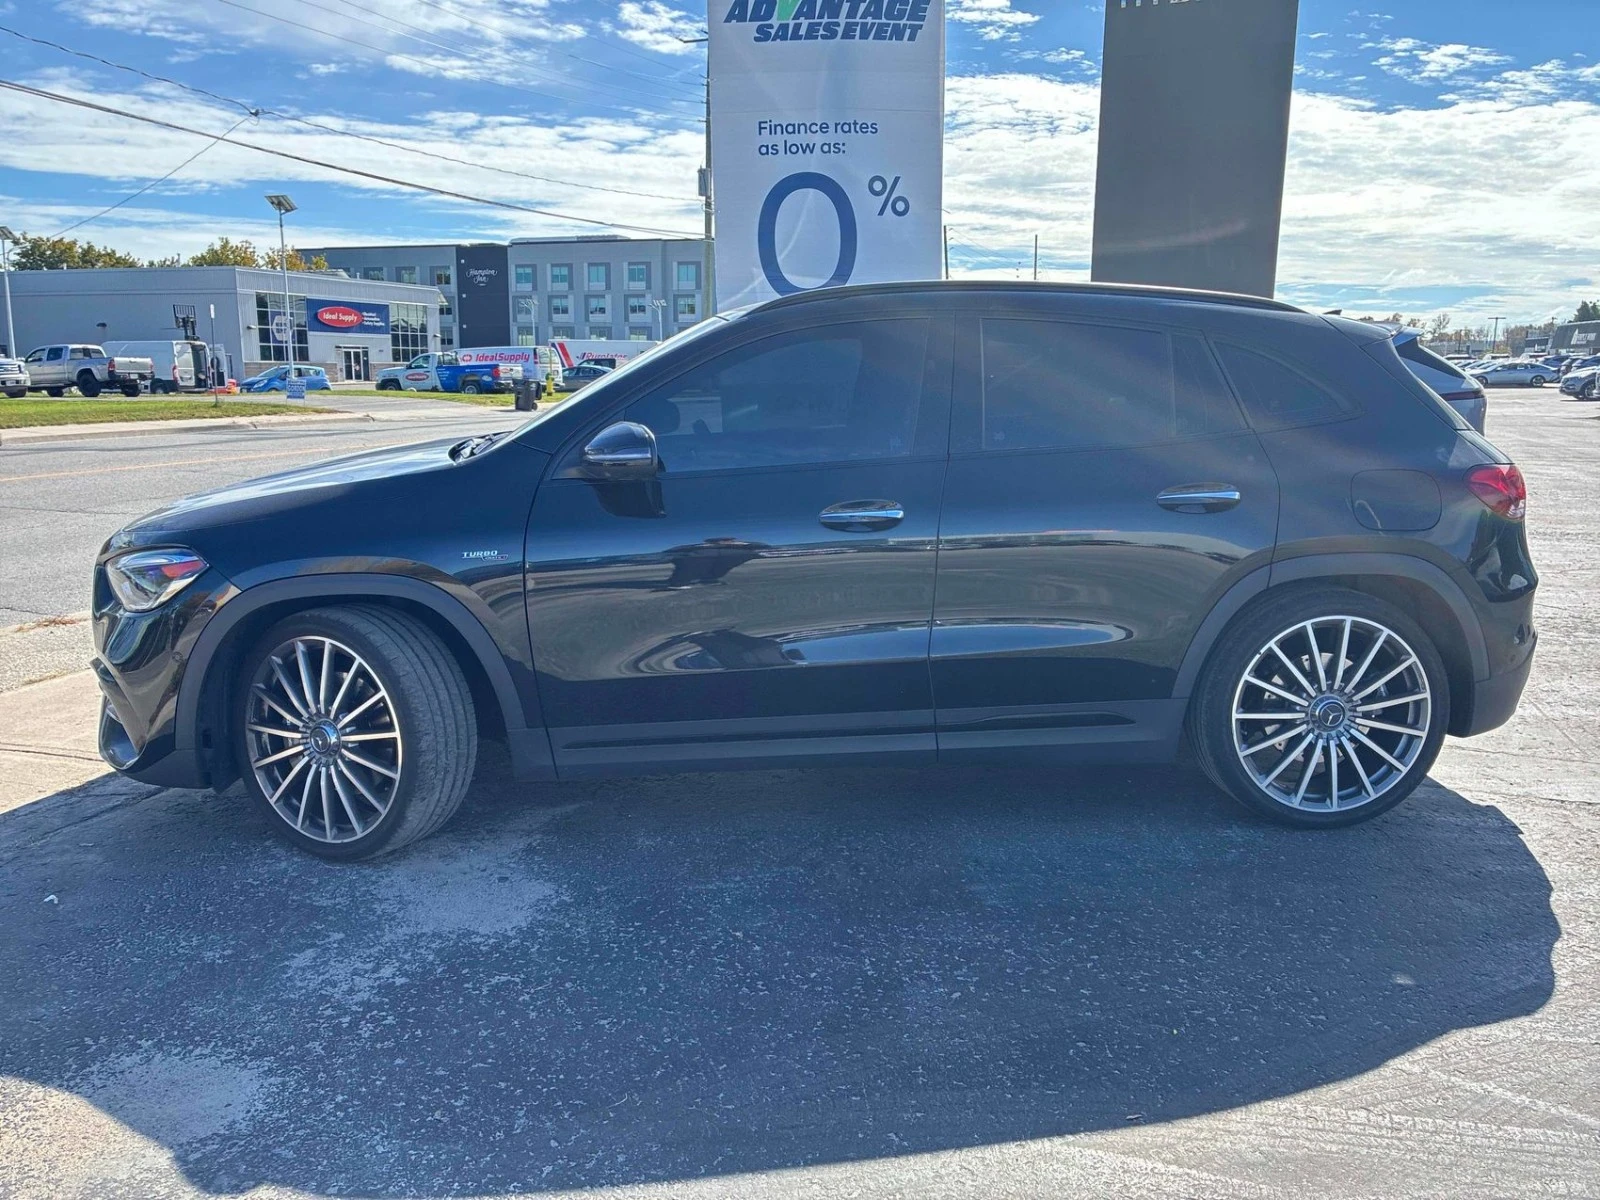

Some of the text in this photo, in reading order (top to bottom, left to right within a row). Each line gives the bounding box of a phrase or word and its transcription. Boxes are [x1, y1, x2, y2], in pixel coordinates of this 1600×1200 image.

[723, 0, 931, 23] ADVANTAGE
[753, 21, 923, 42] SALES EVENT
[758, 120, 878, 136] Finance rates
[758, 140, 846, 156] as low as:
[323, 312, 338, 320] Ideal
[339, 313, 358, 323] Supply
[462, 550, 498, 559] TURBO
